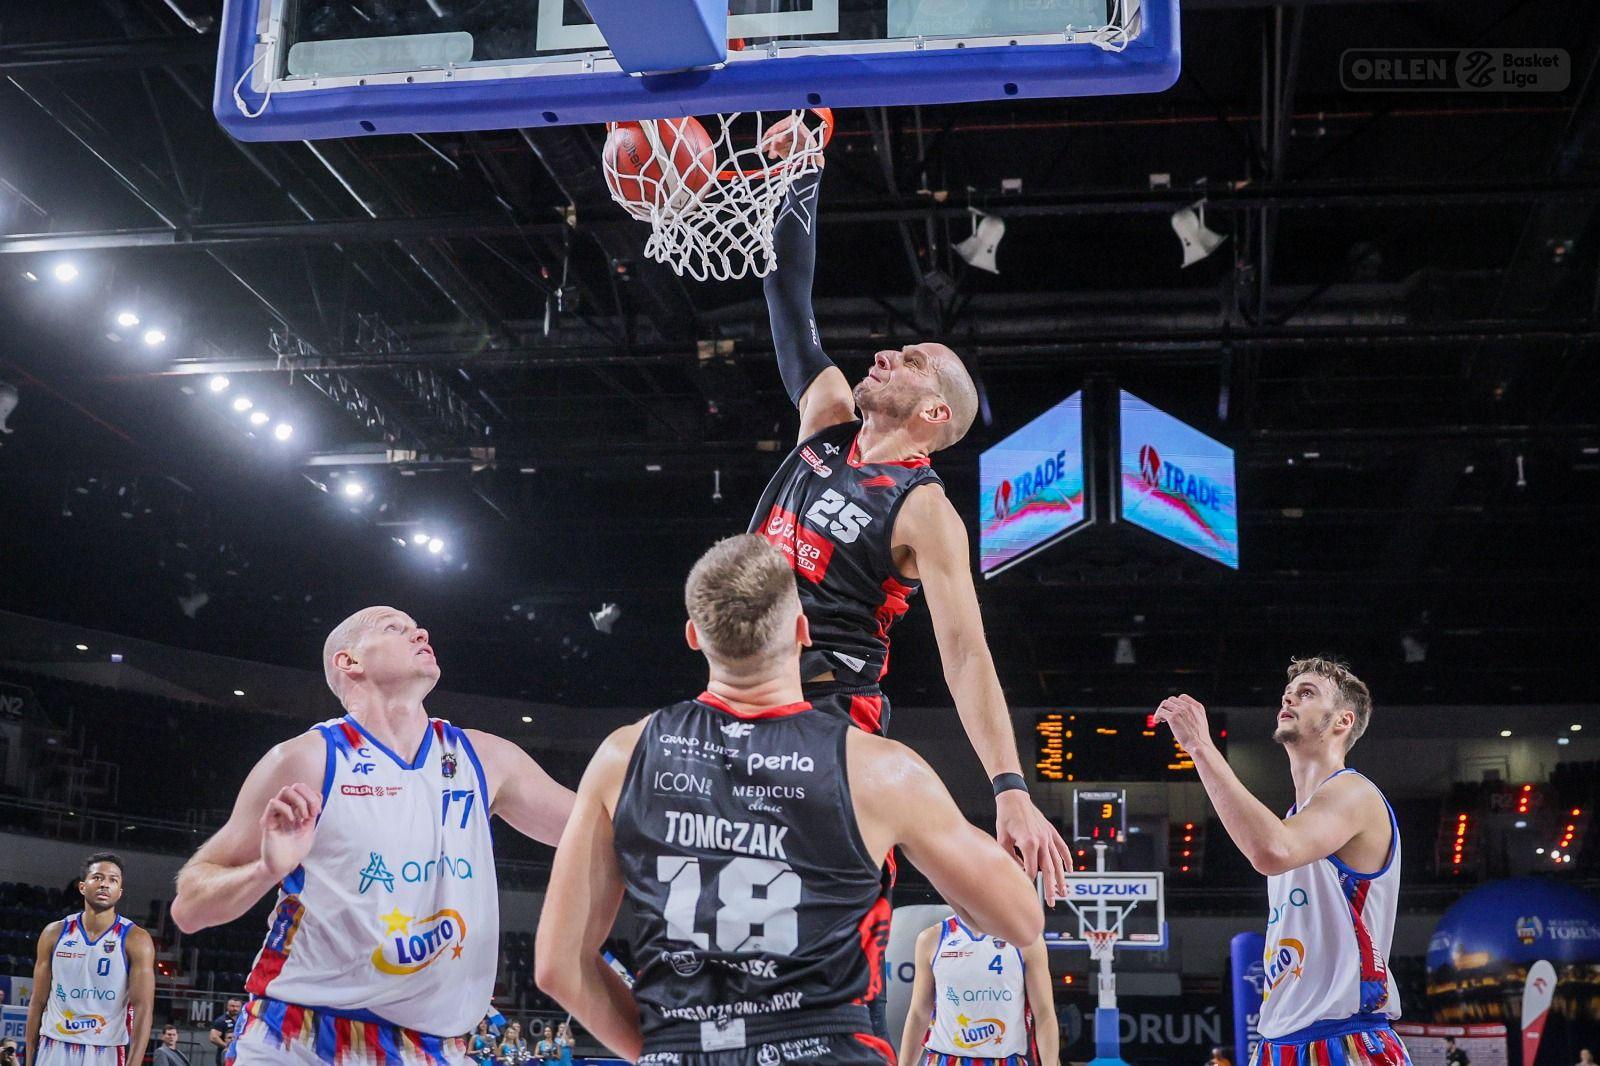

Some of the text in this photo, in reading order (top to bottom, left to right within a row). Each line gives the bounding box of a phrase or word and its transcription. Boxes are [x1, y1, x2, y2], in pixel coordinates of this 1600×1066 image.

[1014, 449, 1066, 504] TRADE
[1163, 460, 1220, 512] TRADE
[805, 487, 873, 544] 25
[660, 734, 700, 747] GRAND
[357, 748, 371, 758] C
[747, 752, 815, 776] perla
[654, 771, 706, 794] ICON
[732, 785, 805, 799] MEDICUS
[665, 811, 789, 860] TOMCZAK
[1075, 884, 1147, 895] SUZUKI
[657, 856, 802, 956] 18
[395, 919, 454, 964] LOTTO
[97, 958, 110, 976] 0
[988, 955, 1003, 974] 4
[70, 987, 116, 1000] arriva
[963, 987, 1012, 1002] arriva
[191, 1001, 213, 1024] M1
[4, 1022, 25, 1037] PIE
[65, 1018, 97, 1030] LOTTO
[962, 1024, 995, 1042] LOTTO
